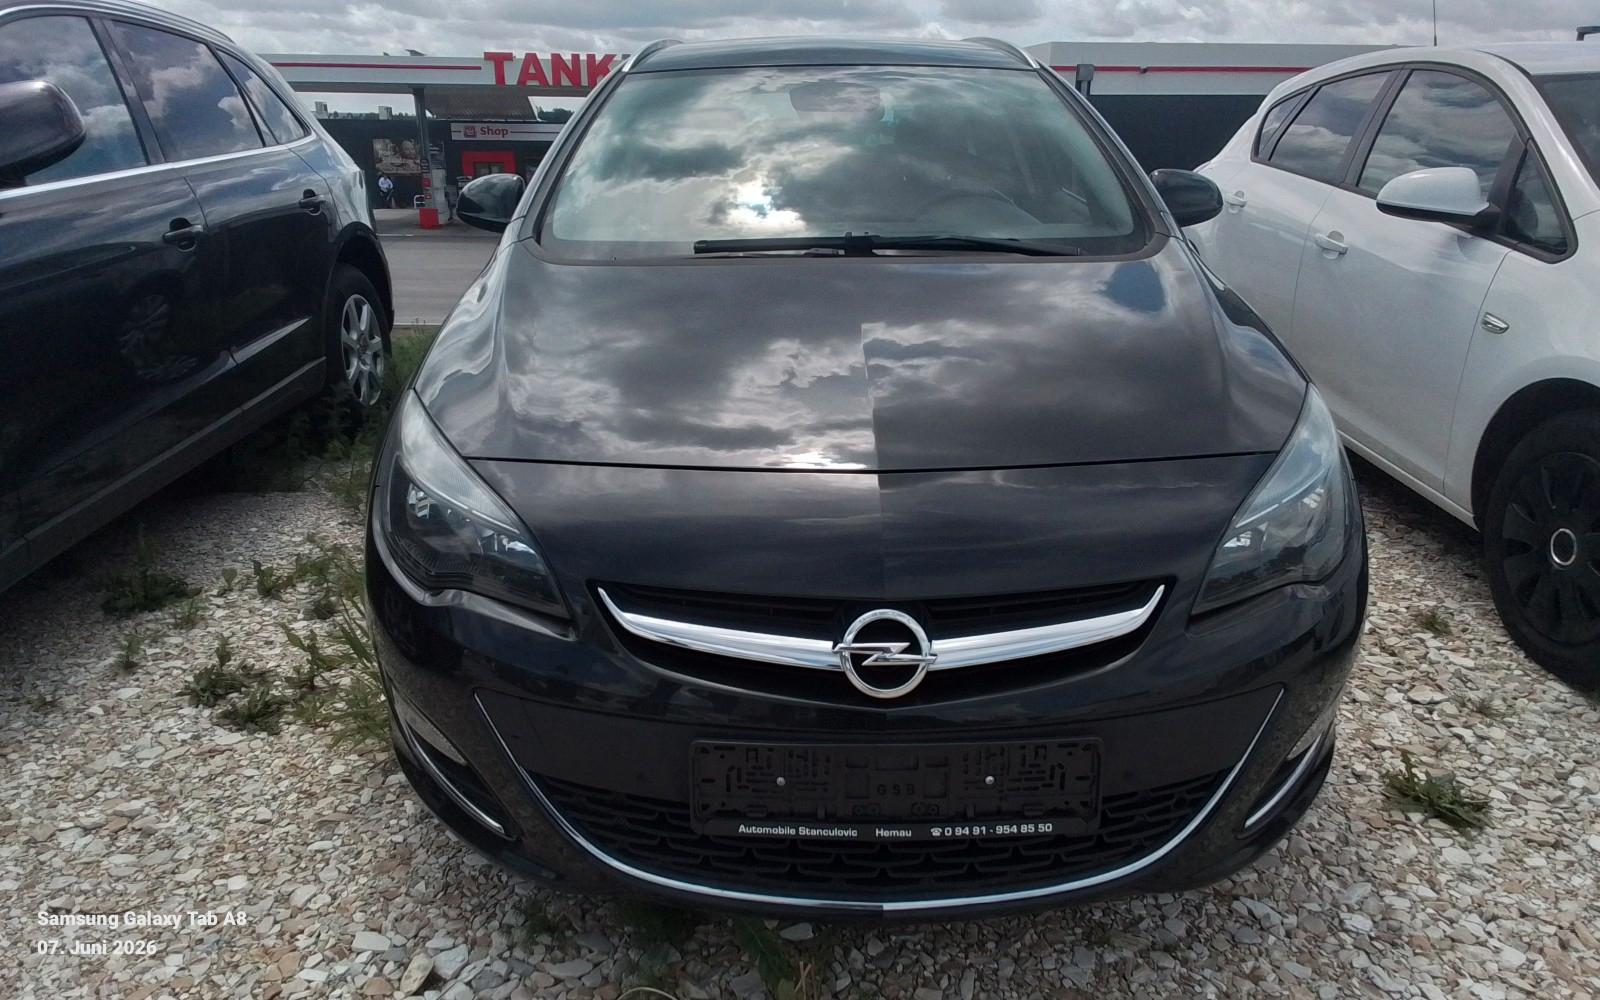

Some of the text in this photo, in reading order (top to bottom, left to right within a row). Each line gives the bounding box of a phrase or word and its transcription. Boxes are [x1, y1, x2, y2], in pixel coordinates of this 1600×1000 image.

[484, 52, 631, 89] TANK
[480, 125, 509, 138] Shop
[739, 824, 796, 835] Automobile
[799, 826, 858, 837] Stanculovic
[875, 828, 912, 837] Hemau
[955, 826, 970, 836] 94
[972, 826, 987, 835] 91
[995, 825, 1018, 834] 954
[1020, 824, 1036, 833] 85
[1038, 823, 1053, 832] 50
